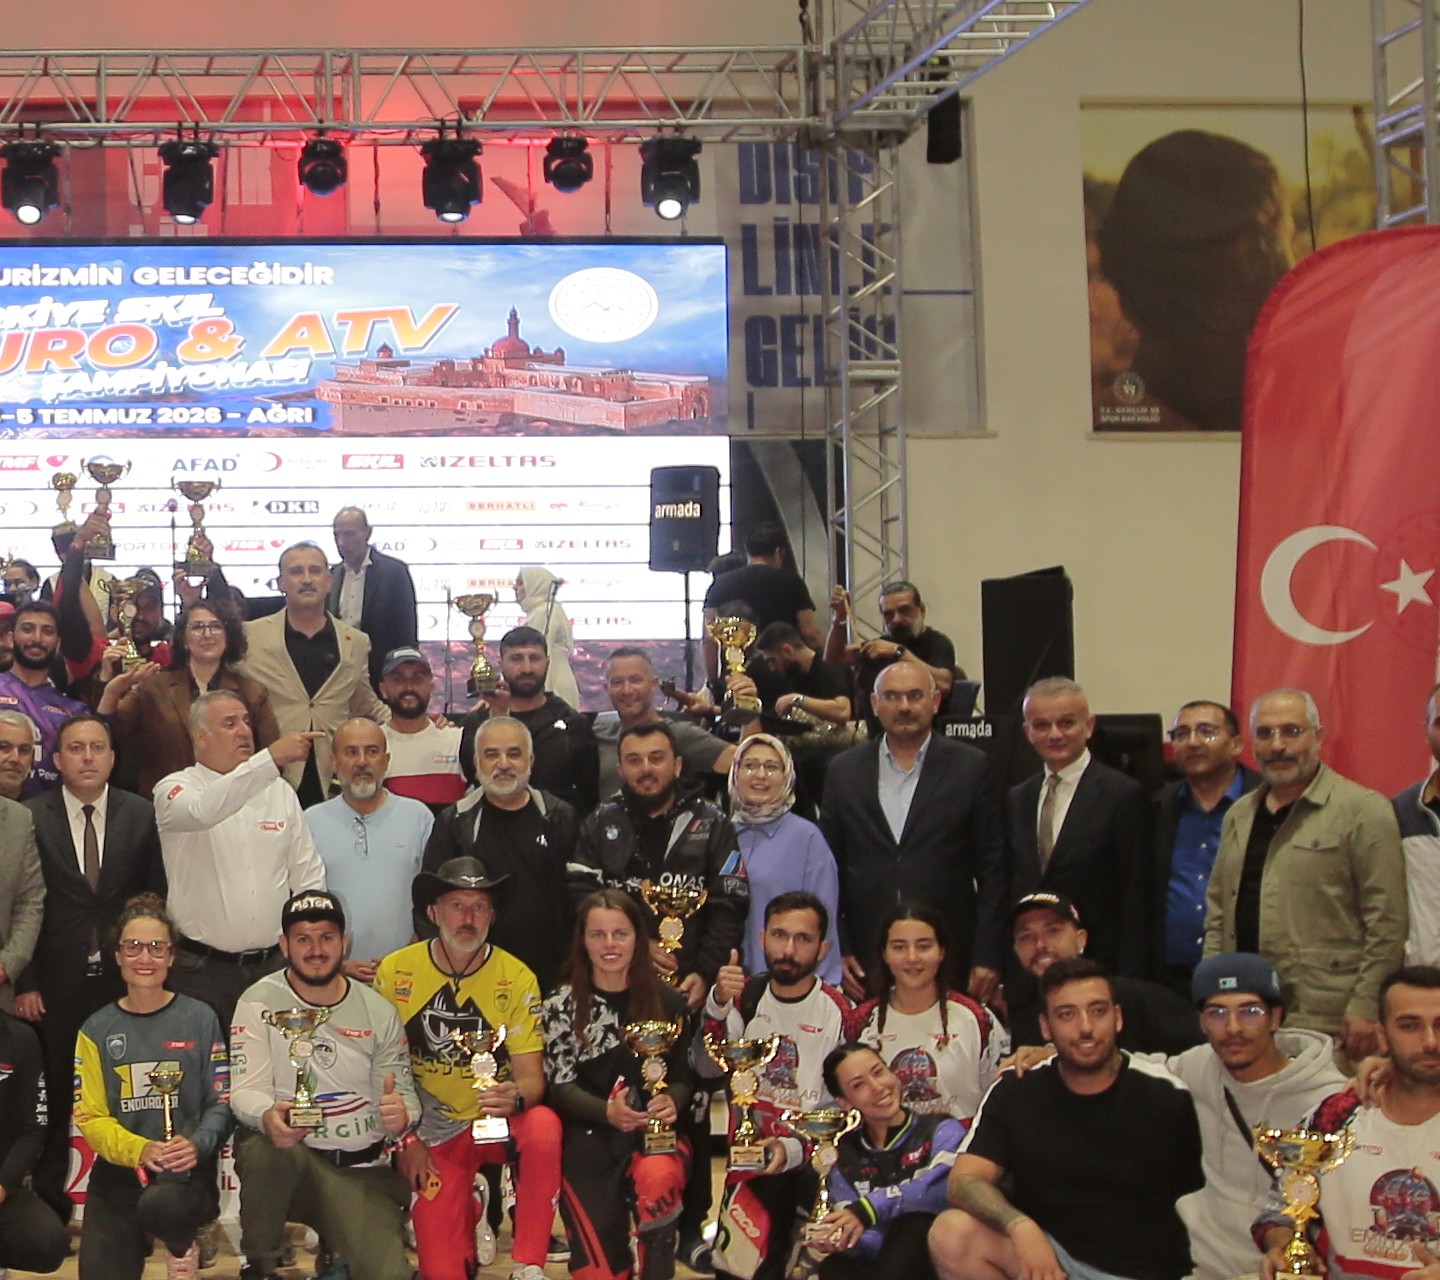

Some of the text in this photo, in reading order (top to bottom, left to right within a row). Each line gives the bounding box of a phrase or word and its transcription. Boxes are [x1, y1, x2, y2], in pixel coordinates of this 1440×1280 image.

[133, 261, 334, 288] GELECEĞİDİR
[177, 317, 246, 361] &
[260, 303, 460, 357] ATV
[40, 361, 310, 402] ŞAMPİYONASI
[39, 408, 155, 426] TEMMUZ
[157, 407, 221, 426] 2026
[246, 402, 312, 425] AĞRI
[172, 458, 238, 471] AFAD
[440, 456, 557, 468] IZELTAS
[270, 501, 319, 514] DKR
[653, 500, 702, 519] armada
[548, 539, 631, 549] IZELTAS
[944, 720, 993, 739] armada
